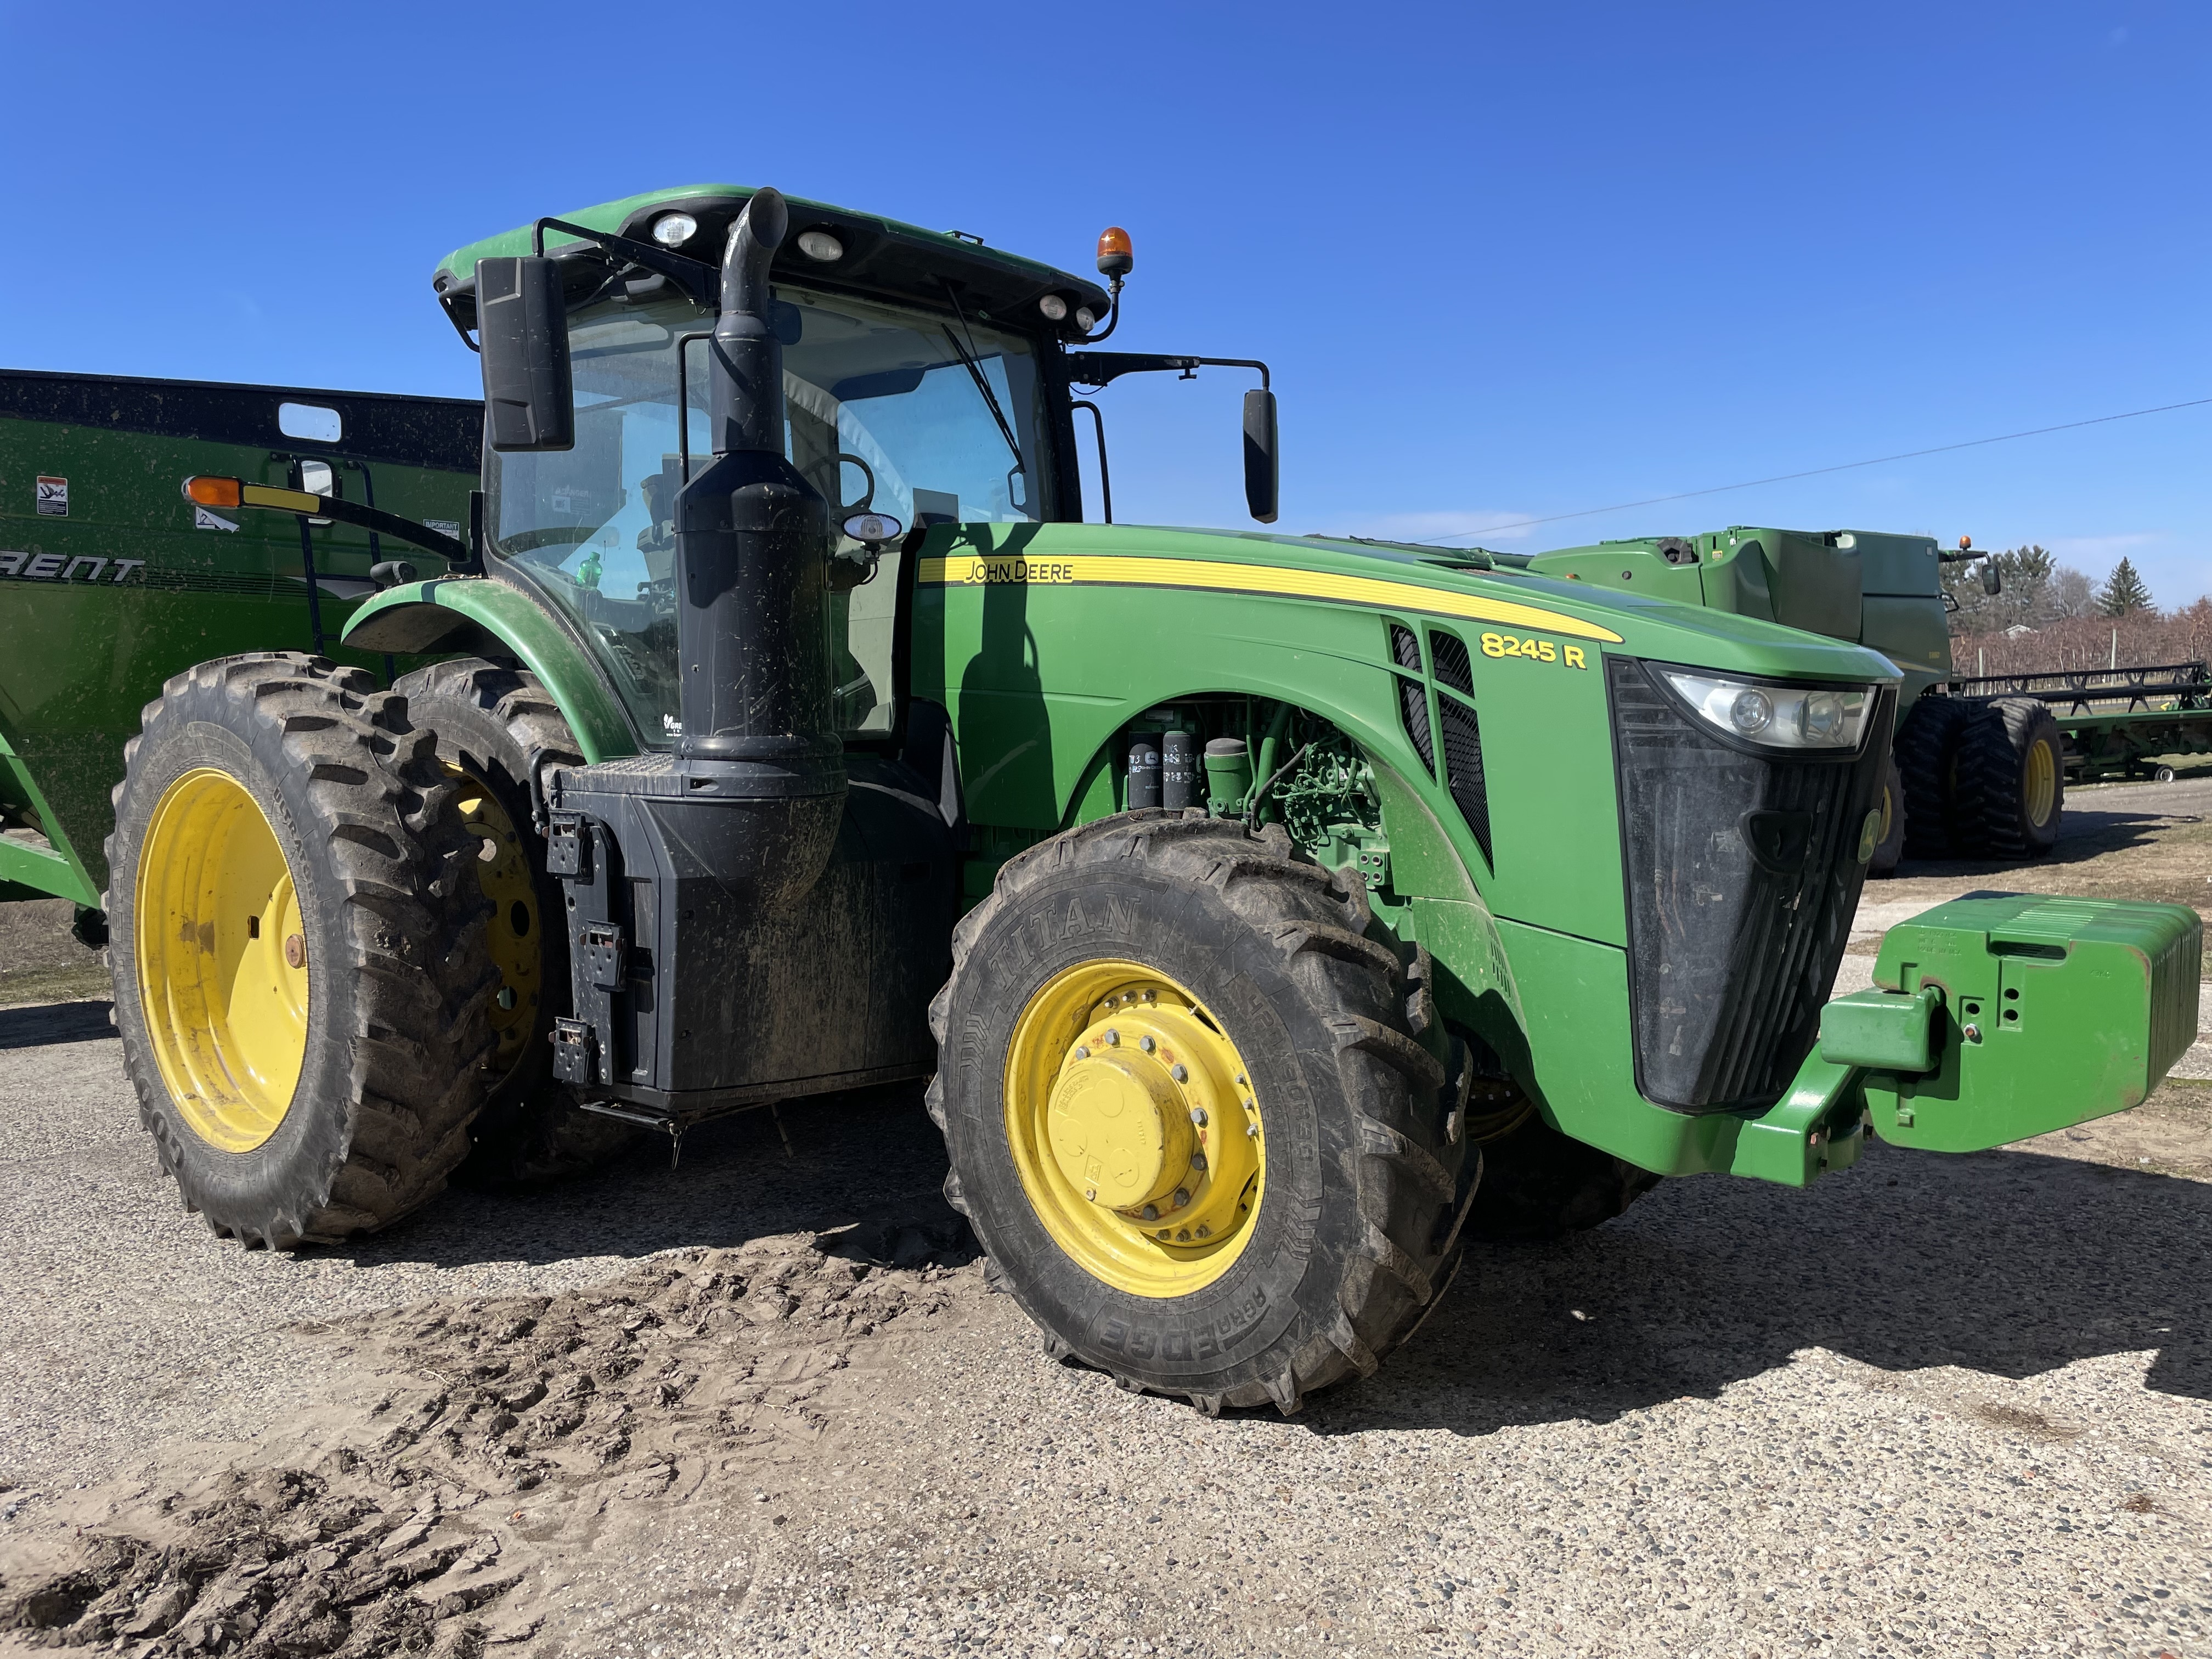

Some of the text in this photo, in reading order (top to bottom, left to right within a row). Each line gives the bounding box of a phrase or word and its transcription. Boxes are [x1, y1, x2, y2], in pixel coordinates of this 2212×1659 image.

[425, 521, 458, 531] IMPORTANT
[966, 560, 1074, 581] JOHN DEERE
[1480, 632, 1588, 670] 8245 R
[988, 890, 1142, 992] TITAN
